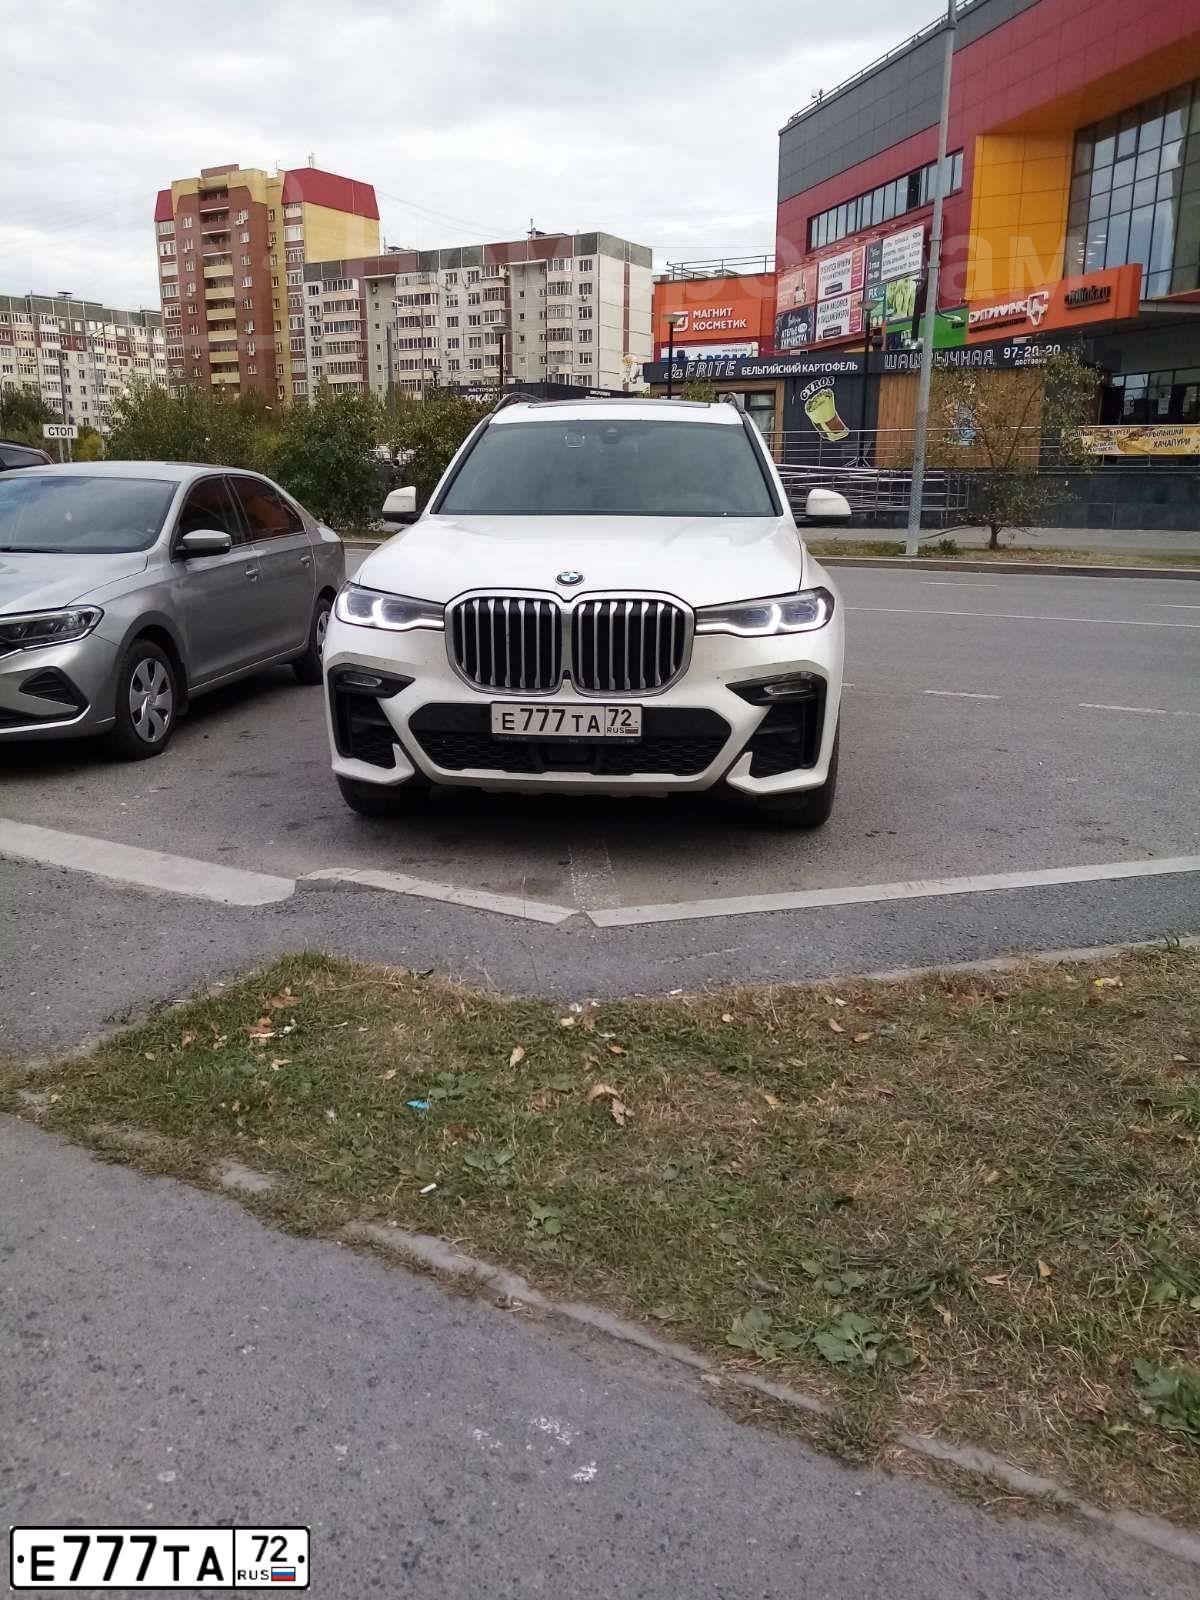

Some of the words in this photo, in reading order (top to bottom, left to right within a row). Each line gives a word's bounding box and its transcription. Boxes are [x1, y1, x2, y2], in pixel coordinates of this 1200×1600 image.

[692, 307, 734, 319] МАГНИТ
[692, 319, 748, 331] КОСМЕТИК
[884, 349, 994, 370] ШАШЫЧНАЯ
[685, 361, 737, 378] FRITE
[741, 362, 801, 376] БЕЛЬГИЙСКИЙ
[802, 361, 859, 373] КАРТОФЕЛЬ
[800, 376, 836, 401] GYROS
[48, 427, 74, 437] СТОП
[1152, 438, 1191, 448] ХАЧАПУРИ
[607, 709, 632, 726] 72
